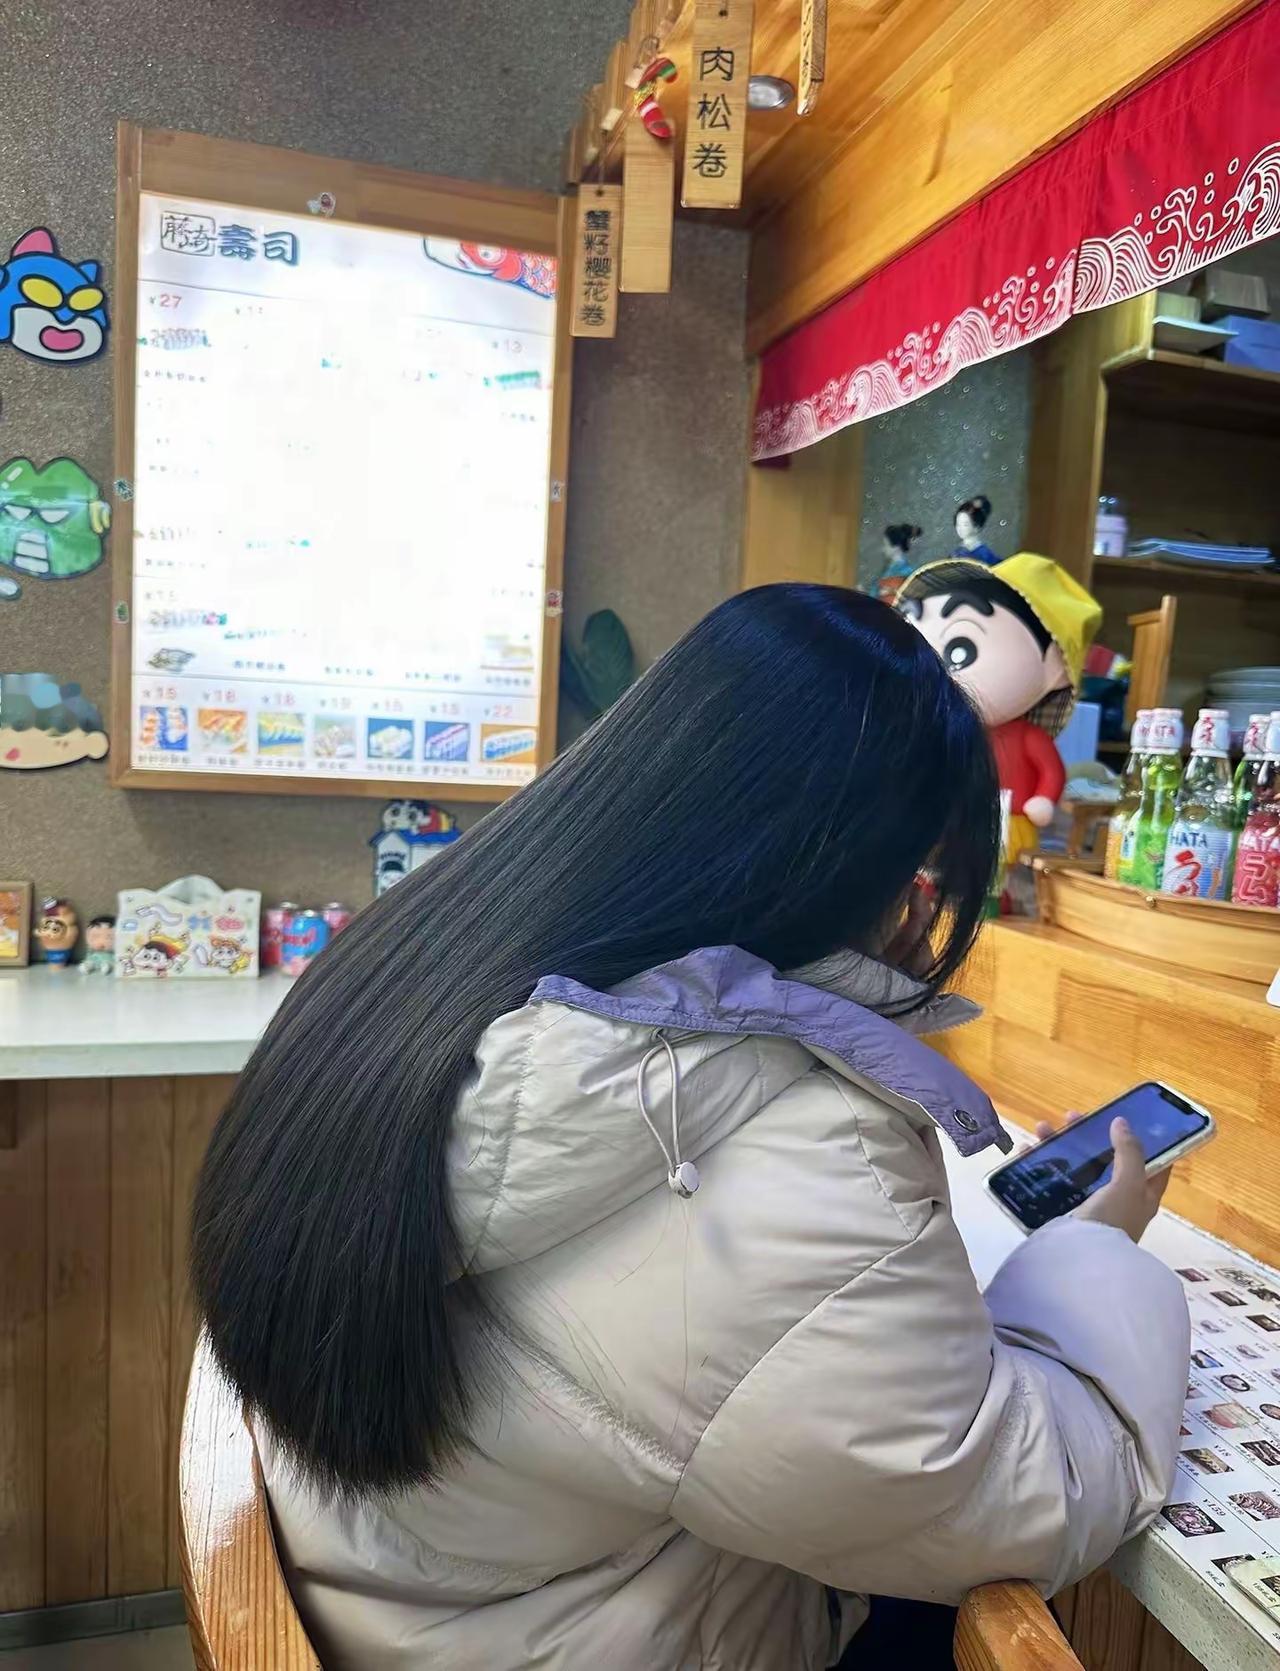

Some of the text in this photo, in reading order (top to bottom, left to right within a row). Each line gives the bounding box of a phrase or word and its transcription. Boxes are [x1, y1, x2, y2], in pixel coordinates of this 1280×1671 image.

[693, 46, 734, 178] 肉松卷
[1169, 831, 1209, 848] HATA
